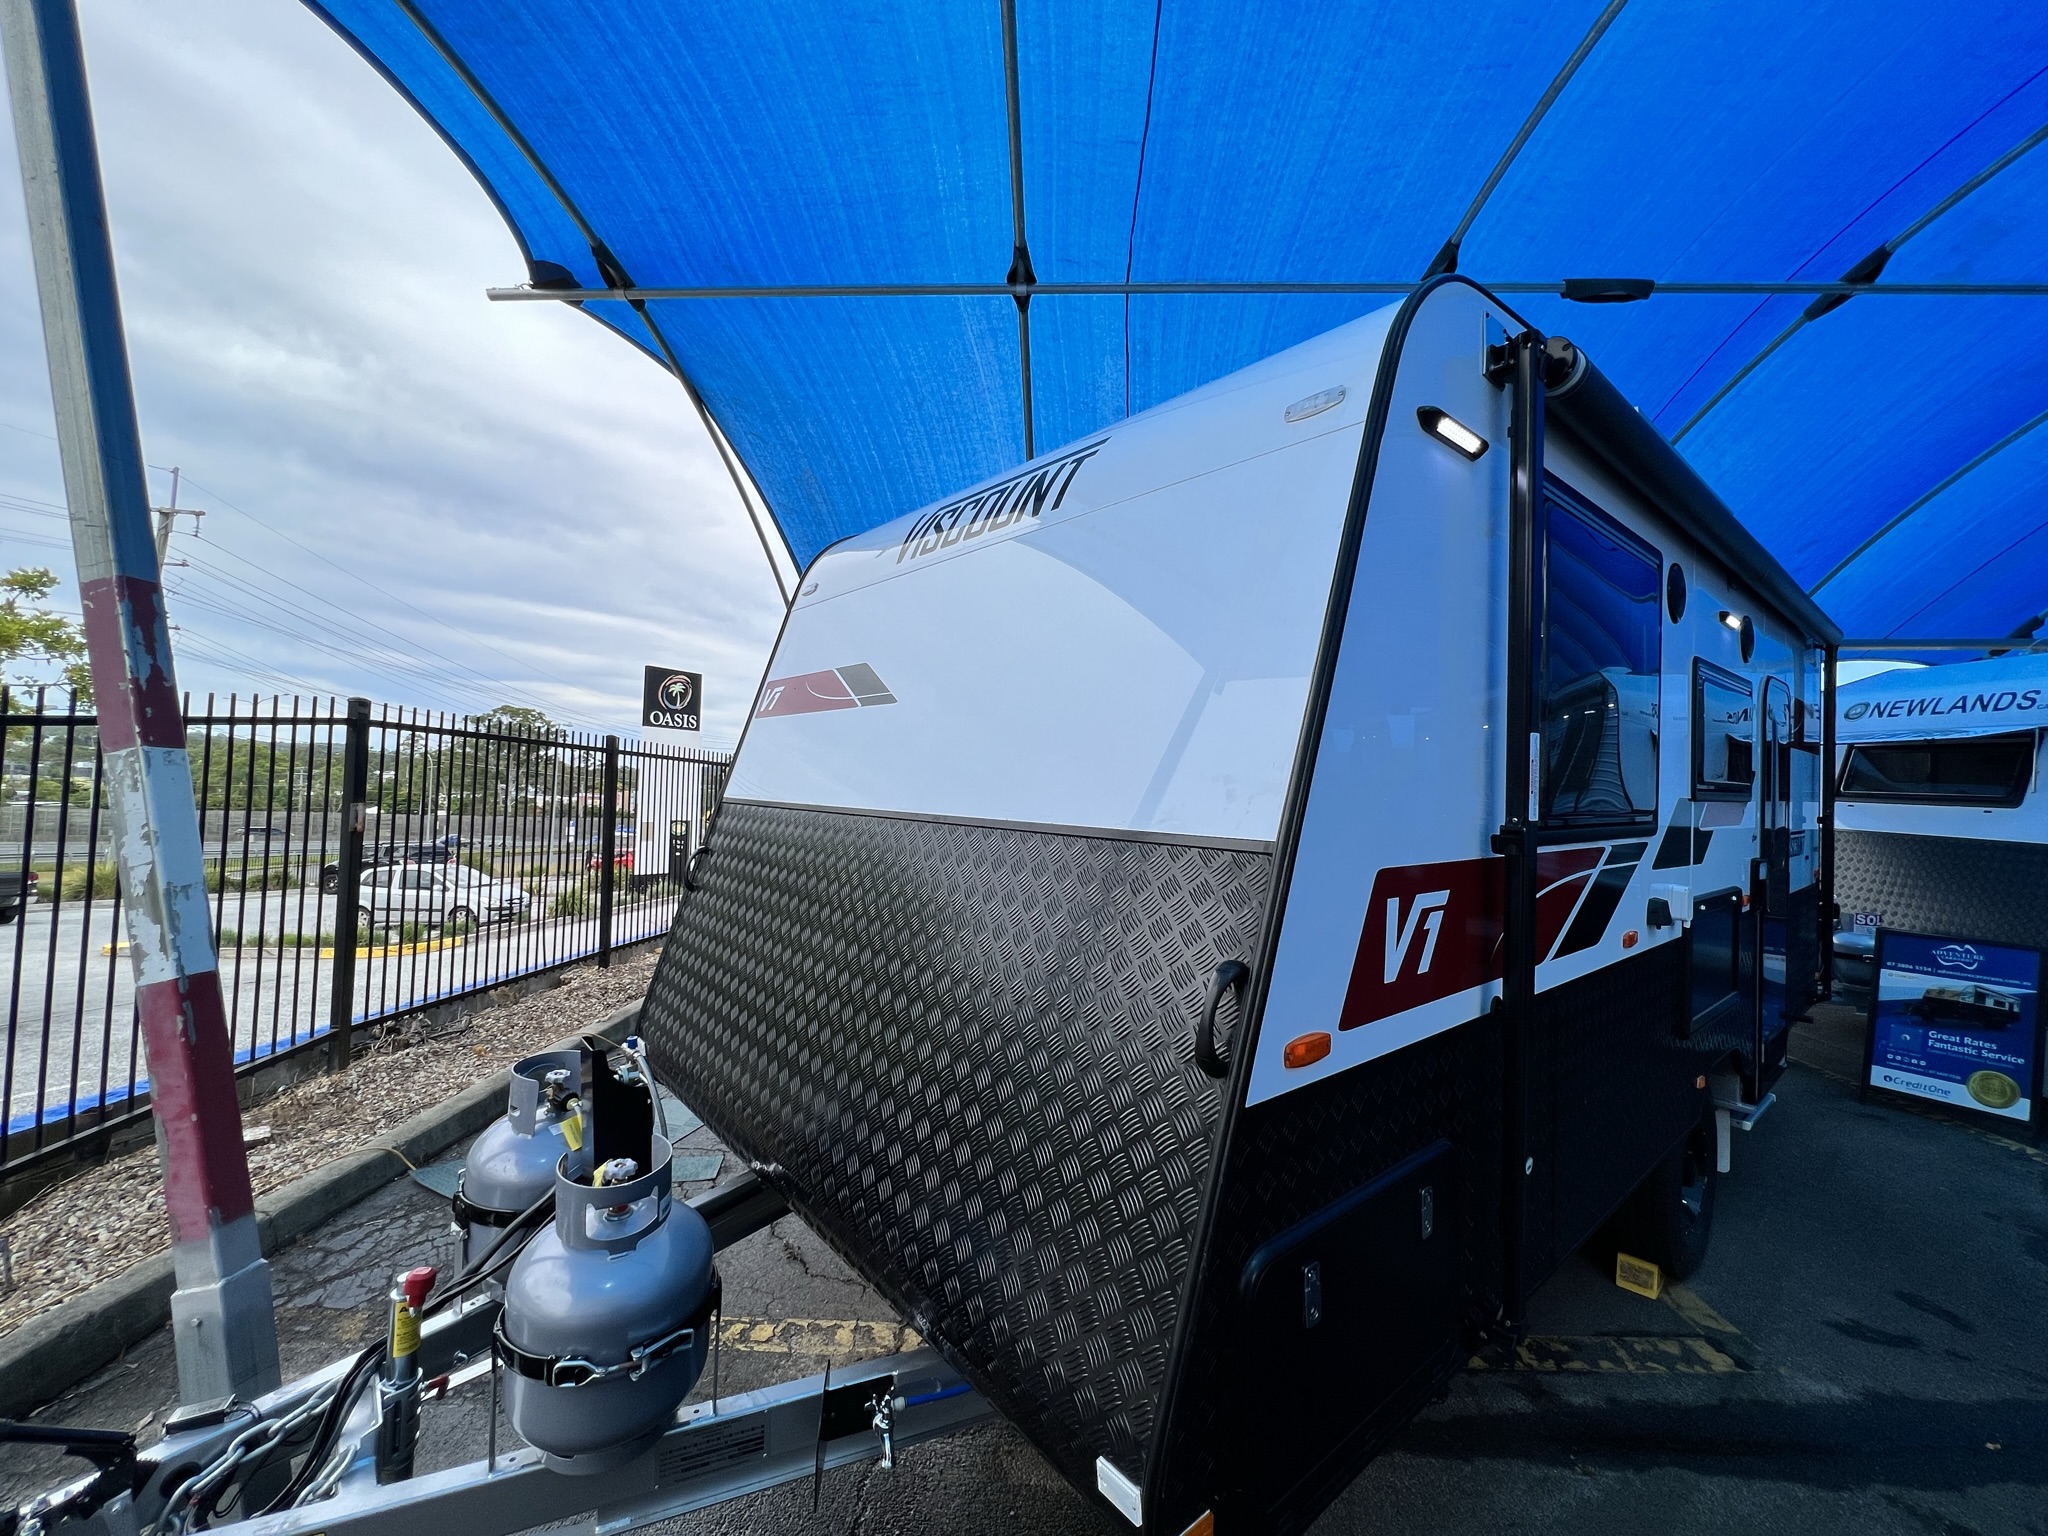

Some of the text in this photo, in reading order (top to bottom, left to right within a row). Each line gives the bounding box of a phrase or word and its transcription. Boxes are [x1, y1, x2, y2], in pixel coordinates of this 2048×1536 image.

[896, 448, 1101, 565] VISCOUNT
[760, 685, 786, 712] V1
[1868, 689, 2042, 719] NEWLANDS
[650, 710, 698, 729] OASIS
[1384, 889, 1451, 984] V1
[1931, 949, 1986, 961] ADVENTURE
[1928, 1030, 1998, 1050] Great Rates
[1928, 1039, 1979, 1056] Fantastic
[1981, 1049, 2026, 1065] Service
[1893, 1076, 1951, 1096] CreditOne
